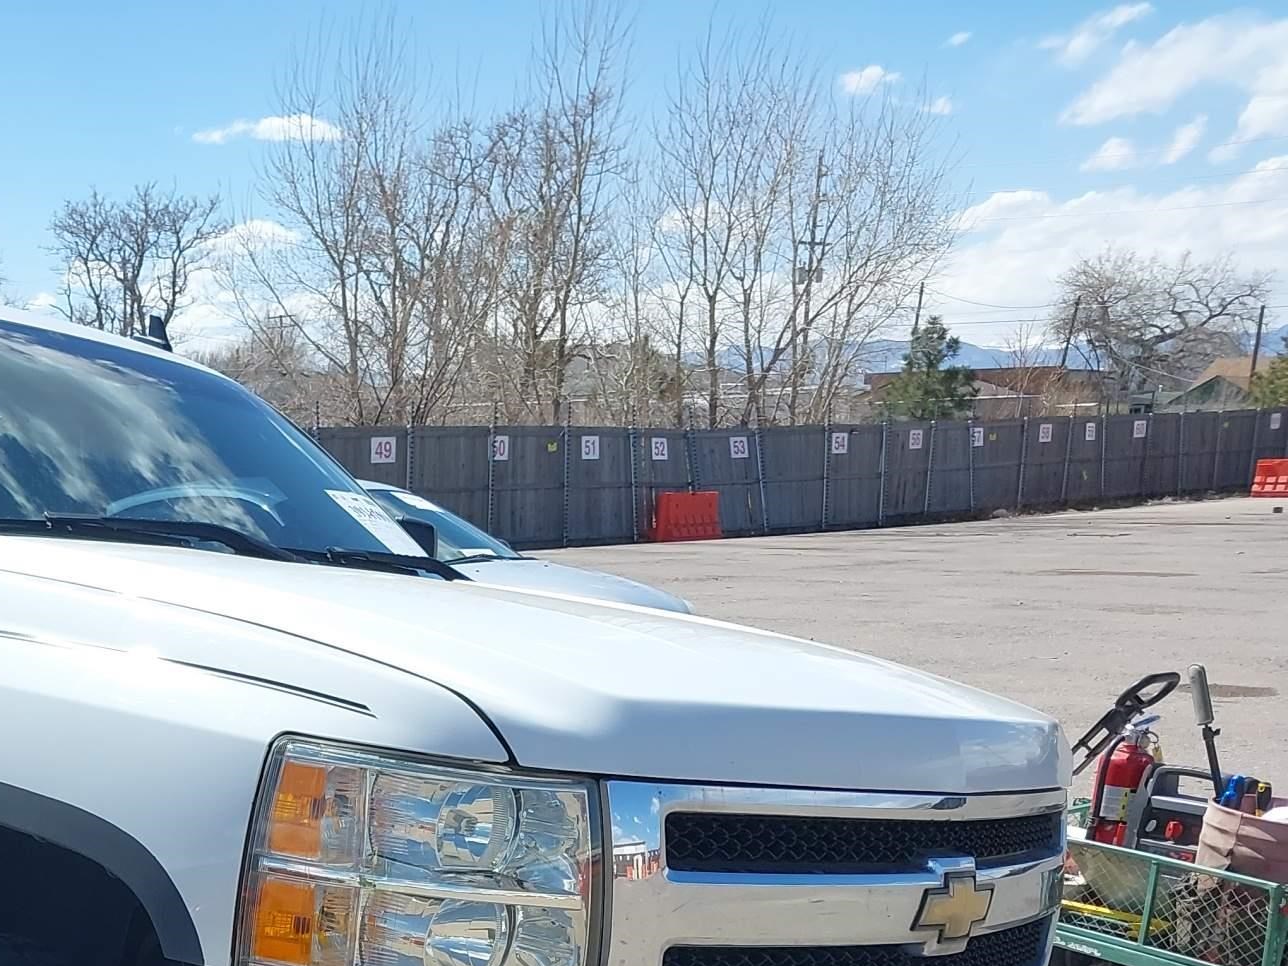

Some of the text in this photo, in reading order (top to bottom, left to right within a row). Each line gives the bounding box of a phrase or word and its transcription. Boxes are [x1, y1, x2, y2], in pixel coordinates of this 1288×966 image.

[374, 441, 393, 459] 49
[584, 440, 596, 456] 51
[654, 441, 666, 457] 52
[733, 440, 746, 455] 53
[834, 436, 846, 451] 54
